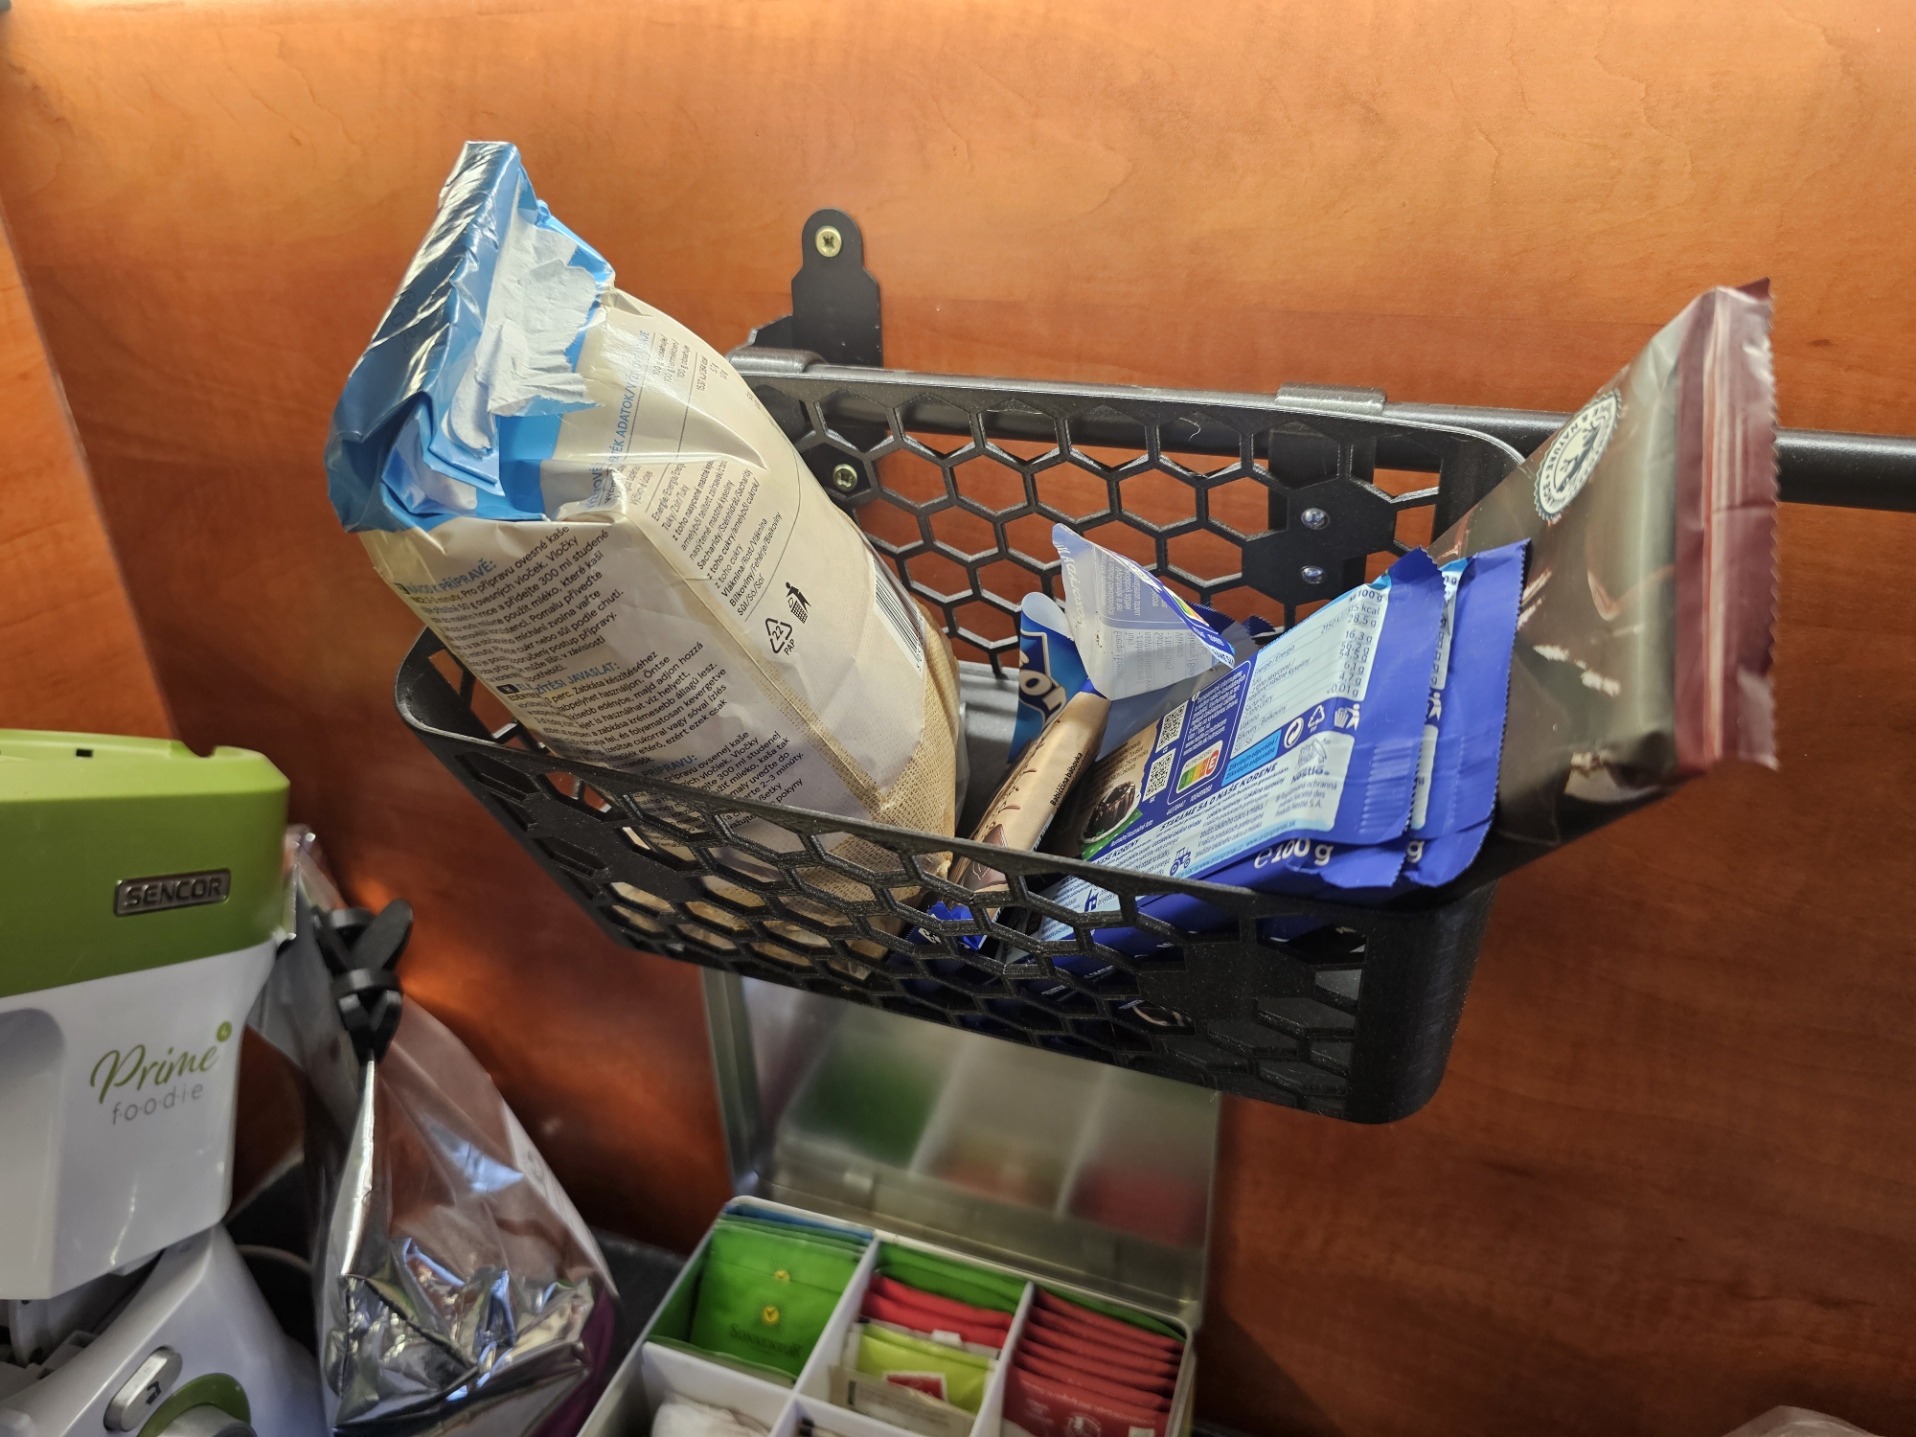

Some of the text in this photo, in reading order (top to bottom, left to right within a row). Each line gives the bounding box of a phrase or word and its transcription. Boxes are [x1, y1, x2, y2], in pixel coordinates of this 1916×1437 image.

[673, 514, 689, 536] toho
[681, 485, 703, 519] nasycené
[685, 524, 712, 562] nasýtené
[704, 500, 724, 528] mastné
[437, 557, 497, 592] PŘÍPRAVĚ:
[460, 523, 570, 600] Pro přípravu ovesné kaše
[473, 533, 580, 609] ovesných vloček. Vločky
[501, 580, 542, 610] přidejte
[537, 565, 560, 587] 300
[557, 555, 573, 573] ml
[570, 527, 610, 563] studené
[708, 552, 724, 574] toho
[716, 542, 745, 583] toho cukry
[502, 600, 531, 625] použít
[529, 582, 563, 609] mléko,
[559, 563, 587, 588] které
[513, 587, 602, 643] míchání zvolna vařte
[529, 597, 565, 624] Pomalu
[1361, 604, 1381, 615] kcal
[533, 629, 558, 647] nebo
[554, 621, 571, 637] sůl
[569, 605, 598, 632] podle
[547, 608, 618, 654] postup přípravy.
[769, 624, 785, 641] 22
[781, 637, 797, 656] PAP
[565, 660, 620, 684] JAVASLAT:
[571, 676, 606, 696] Zabkása
[603, 649, 659, 687] készítéséhez
[596, 691, 635, 713] edénybe,
[633, 681, 658, 700] majd
[655, 661, 682, 687] adjon
[677, 639, 704, 666] hozzá
[596, 659, 718, 737] zabkása krémesebb állagú lesz.
[601, 699, 647, 724] használhat
[656, 668, 692, 700] helyett,
[628, 703, 685, 739] folyamatosan
[681, 666, 728, 708] kevergetve
[631, 725, 668, 747] cukorral
[665, 714, 689, 733] vagy
[684, 697, 710, 720] sóval
[664, 724, 689, 746] ezért
[686, 711, 709, 731] ezek
[707, 696, 729, 718] csak
[697, 729, 749, 770] ovsenej kaše
[698, 736, 760, 780] vločiek. Vločky
[716, 765, 736, 781] 300
[745, 729, 781, 762] studenej
[728, 735, 791, 785] mlieko, kaša tak
[748, 759, 779, 785] uveďte
[774, 750, 806, 777] minúty.
[1063, 750, 1083, 778] bábovka
[775, 777, 804, 804] pokyny
[1314, 844, 1334, 867] g
[1406, 840, 1425, 863] g
[124, 877, 225, 908] SENCOR
[90, 1044, 220, 1105] Prime
